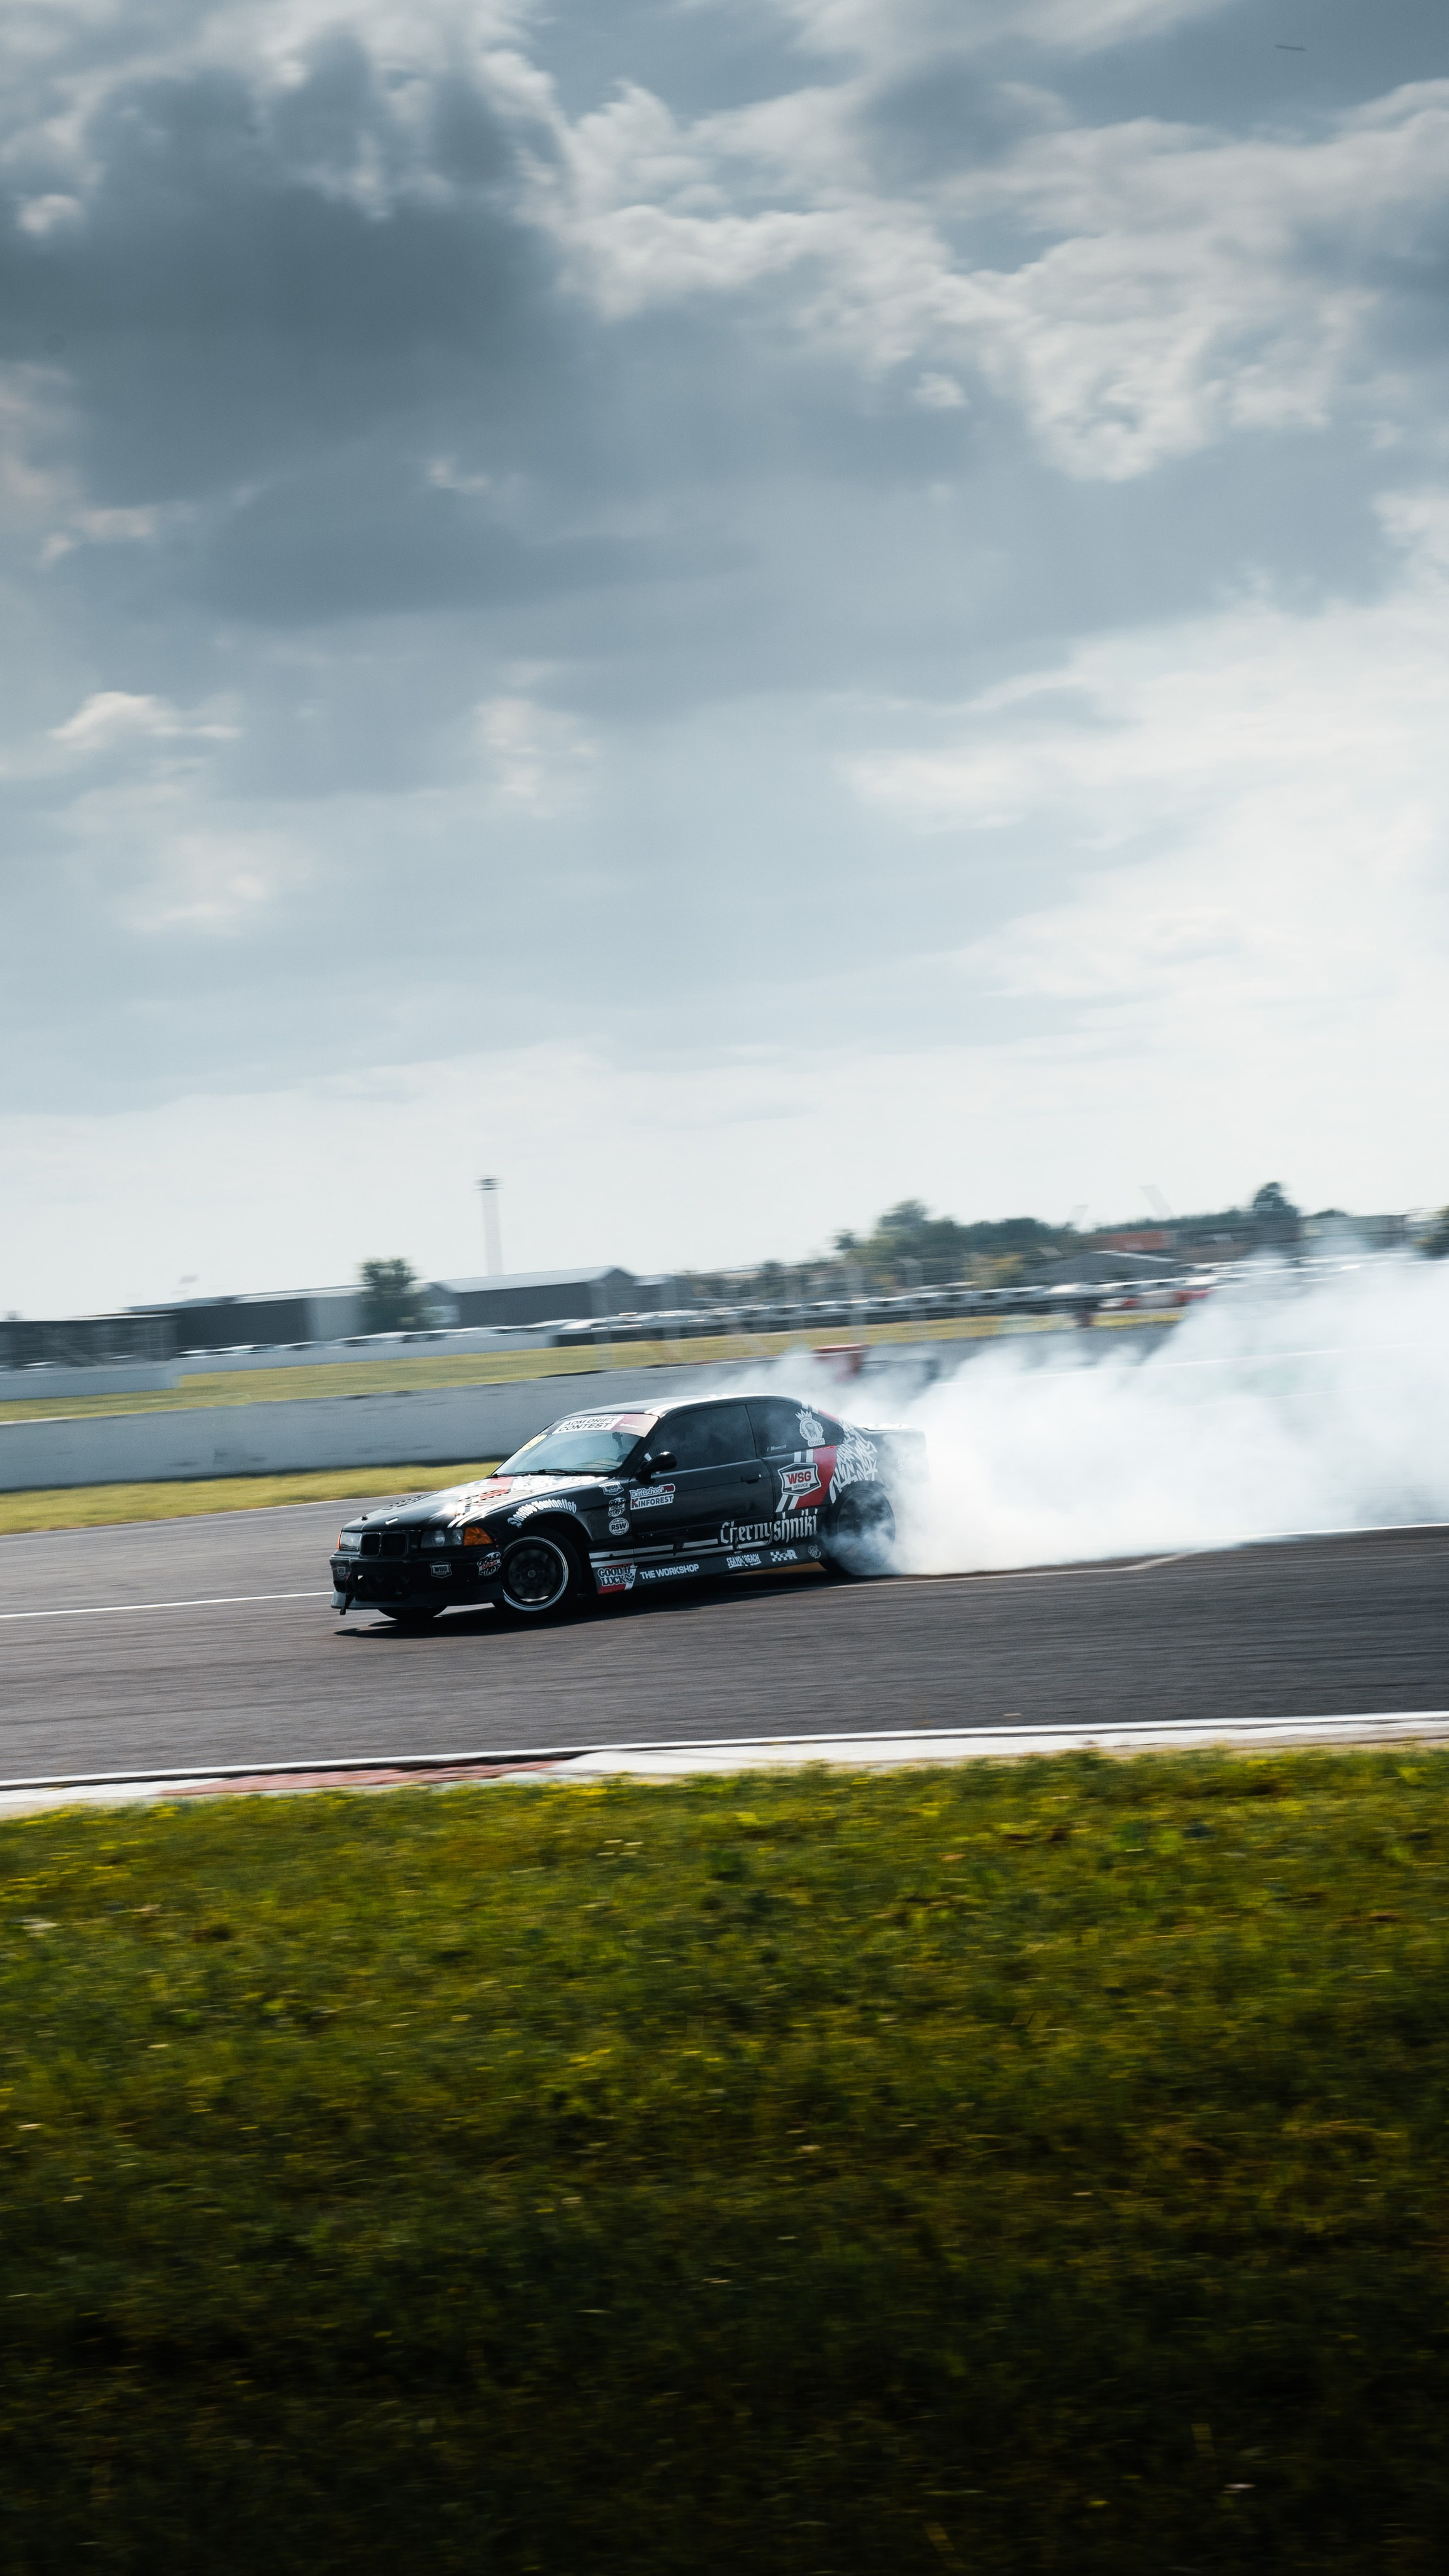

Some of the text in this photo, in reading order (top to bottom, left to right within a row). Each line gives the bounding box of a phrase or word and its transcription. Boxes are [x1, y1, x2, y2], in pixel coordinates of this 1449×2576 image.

[558, 1423, 612, 1431] CONTEST
[787, 1471, 811, 1484] WSG
[631, 1486, 663, 1497] Driftschool
[631, 1495, 673, 1509] KINFOREST
[611, 1523, 626, 1531] RSW
[720, 1508, 818, 1544] Chernyshniki
[479, 1552, 501, 1567] GOLD
[598, 1567, 623, 1577] GOOD
[640, 1563, 699, 1580] THE WORKSHOP
[601, 1575, 626, 1585] LUCK
